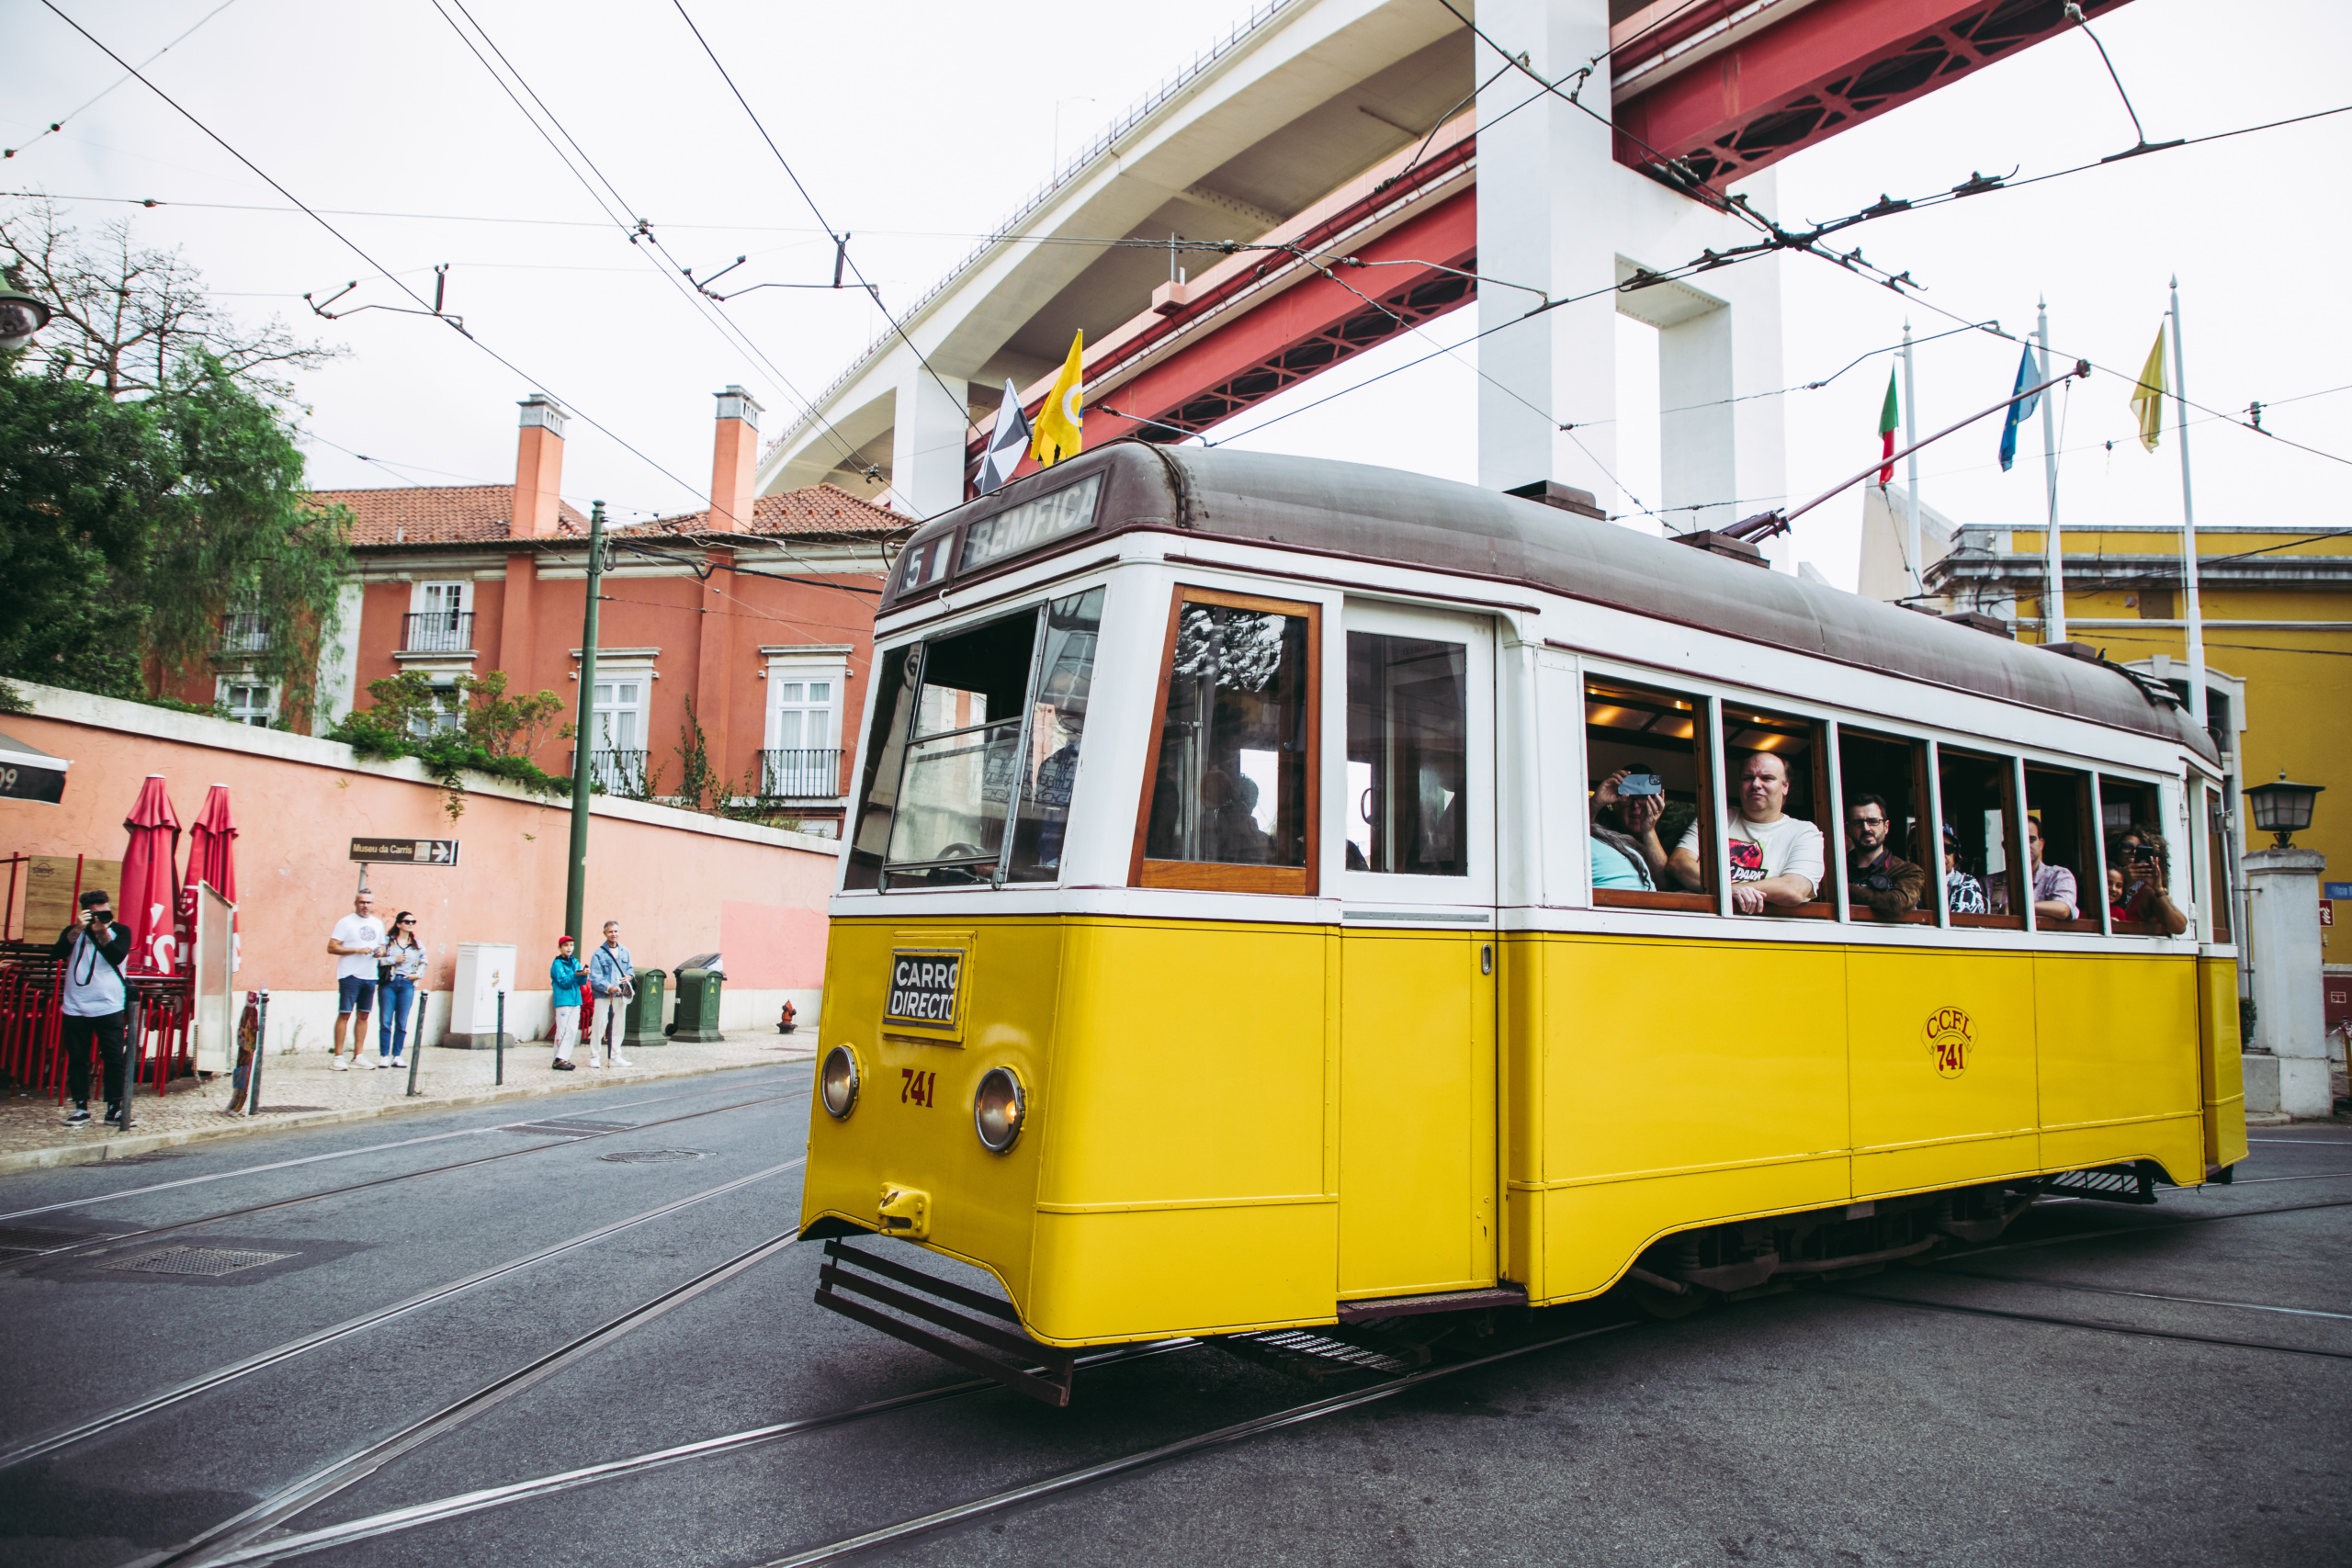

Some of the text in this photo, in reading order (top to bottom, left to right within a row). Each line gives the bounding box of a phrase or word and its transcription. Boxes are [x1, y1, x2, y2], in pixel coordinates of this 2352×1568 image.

[970, 477, 1098, 561] BEMFICA
[353, 843, 413, 854] Museu da Carris
[1732, 867, 1764, 881] PARK
[896, 961, 958, 989] CARRO
[891, 990, 955, 1021] DIRECTO
[1937, 1043, 1964, 1071] 741
[901, 1068, 936, 1108] 741
